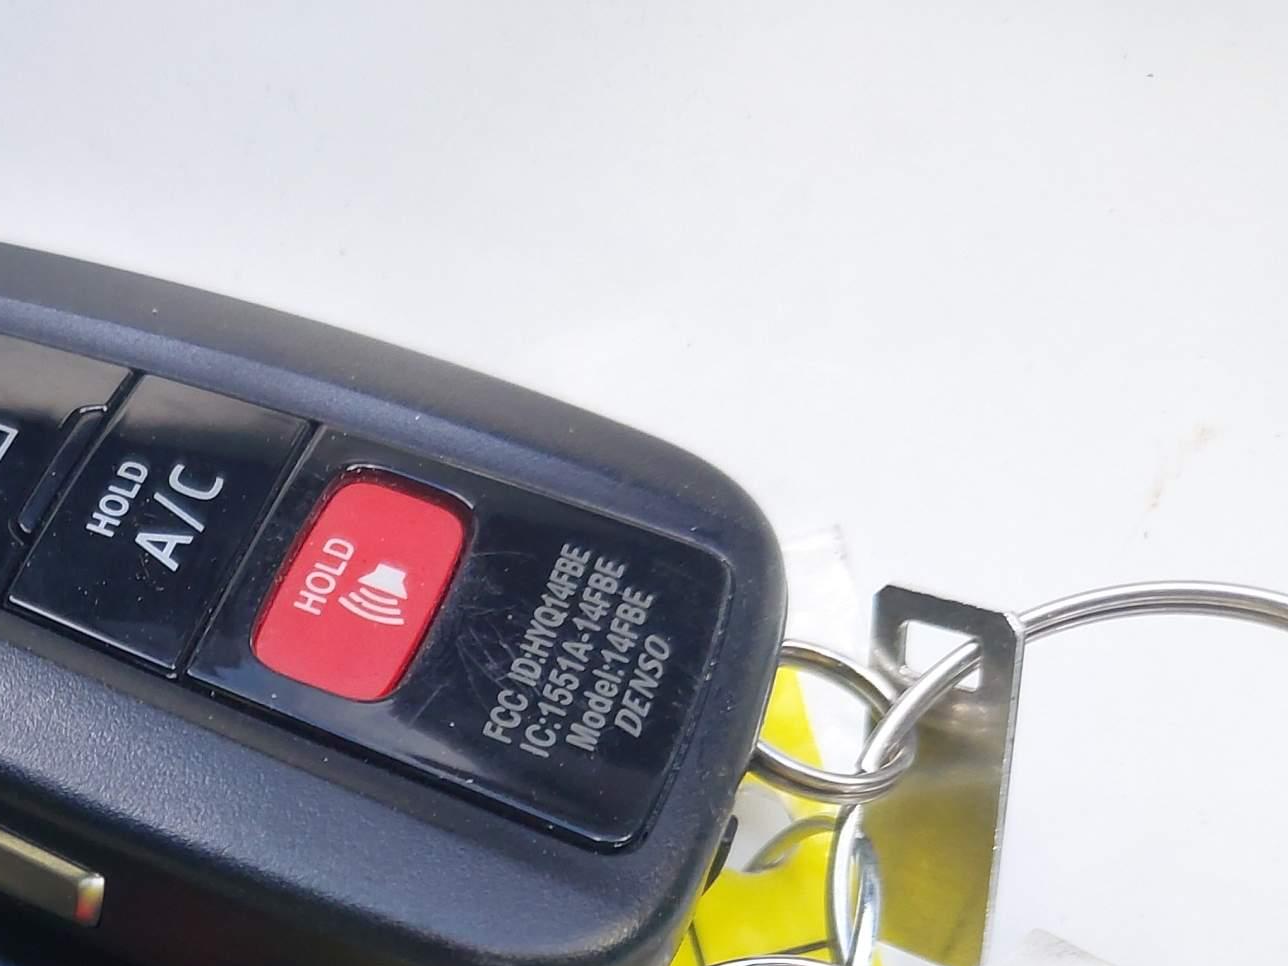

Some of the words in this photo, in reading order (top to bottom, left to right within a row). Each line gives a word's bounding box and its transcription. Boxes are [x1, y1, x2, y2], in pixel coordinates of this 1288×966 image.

[86, 461, 149, 538] HOLD
[134, 463, 224, 572] A/C
[294, 536, 354, 615] HOLD
[483, 689, 529, 744] FCC
[508, 543, 592, 687] ID:HYQ14FBE
[520, 556, 626, 758] IC:1551A-14FBE
[566, 587, 654, 752] Model:14FBE
[614, 634, 670, 738] DENSO
